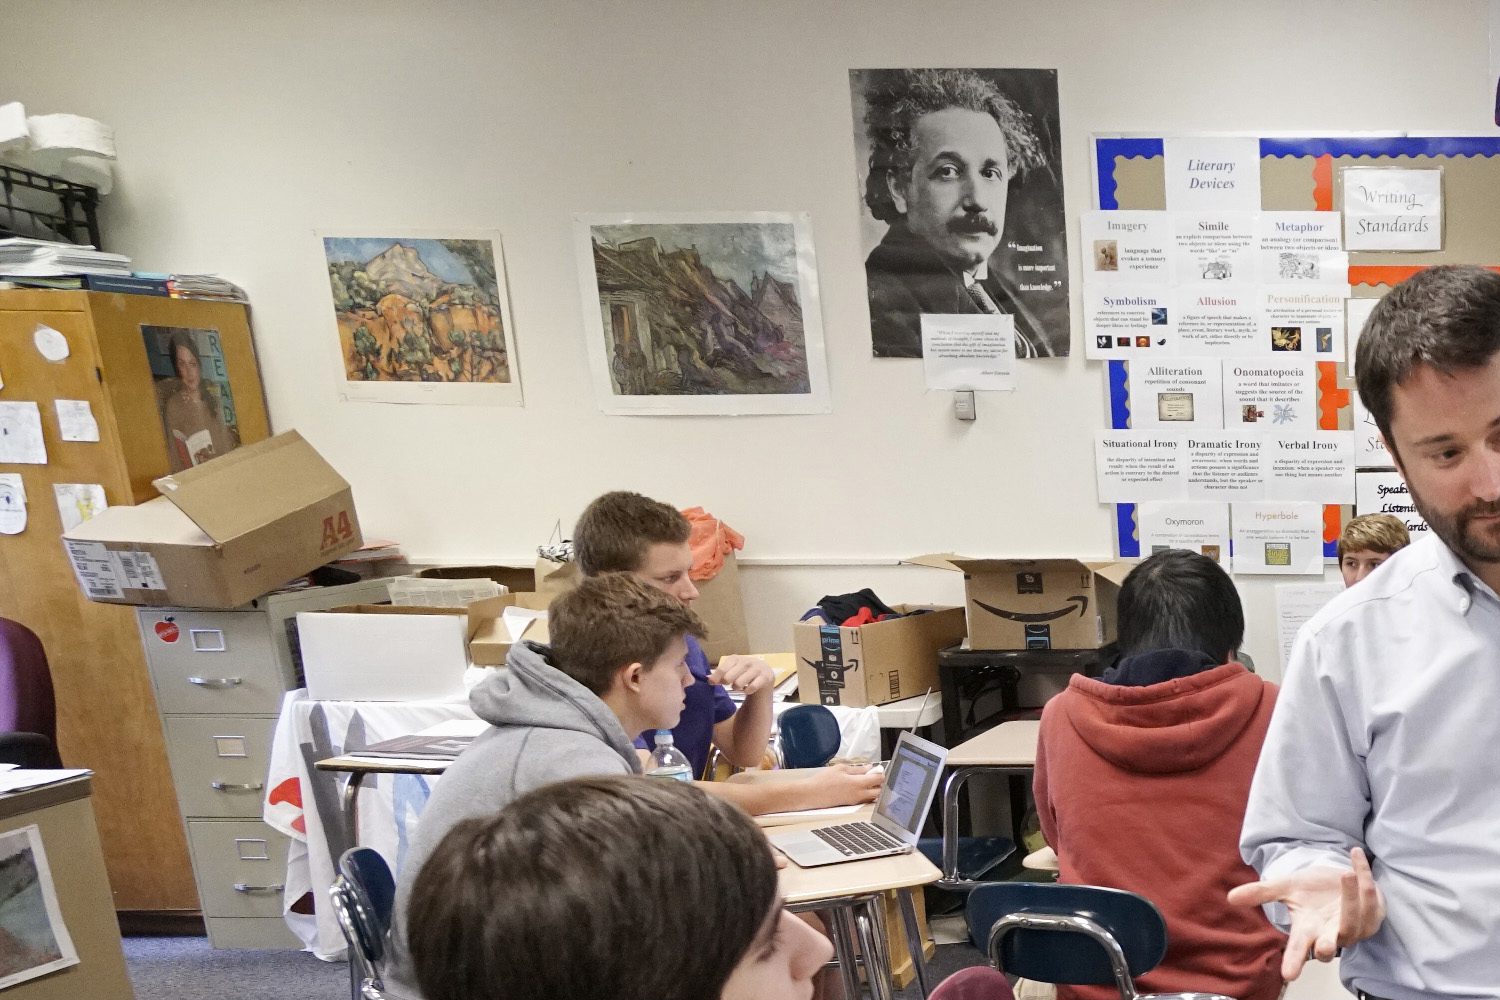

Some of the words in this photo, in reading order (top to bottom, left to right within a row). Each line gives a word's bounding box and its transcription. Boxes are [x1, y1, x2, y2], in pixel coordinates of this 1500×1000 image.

[1187, 158, 1236, 174] Literary
[1189, 177, 1235, 190] Devices
[1359, 185, 1424, 211] Writing
[1107, 220, 1148, 232] Imagery
[1198, 221, 1229, 231] Simile
[1275, 222, 1324, 234] Metaphor
[1356, 218, 1430, 235] Standards
[1104, 296, 1157, 308] Symbolism
[1196, 297, 1237, 306] Allusion
[1267, 294, 1340, 304] Personification
[1148, 366, 1203, 376] Alliteration
[1233, 367, 1304, 379] Onomatopoeia
[208, 334, 234, 423] READ
[1102, 439, 1151, 448] Situational
[1154, 439, 1178, 451] Irony
[1188, 439, 1232, 449] Dramatic
[1235, 439, 1261, 451] Irony
[1278, 440, 1309, 449] Verbal
[1312, 440, 1338, 452] Irony
[1165, 518, 1205, 527] Oxymoron
[1255, 511, 1299, 522] Hyperbole
[320, 511, 352, 550] A4
[822, 636, 839, 645] prime
